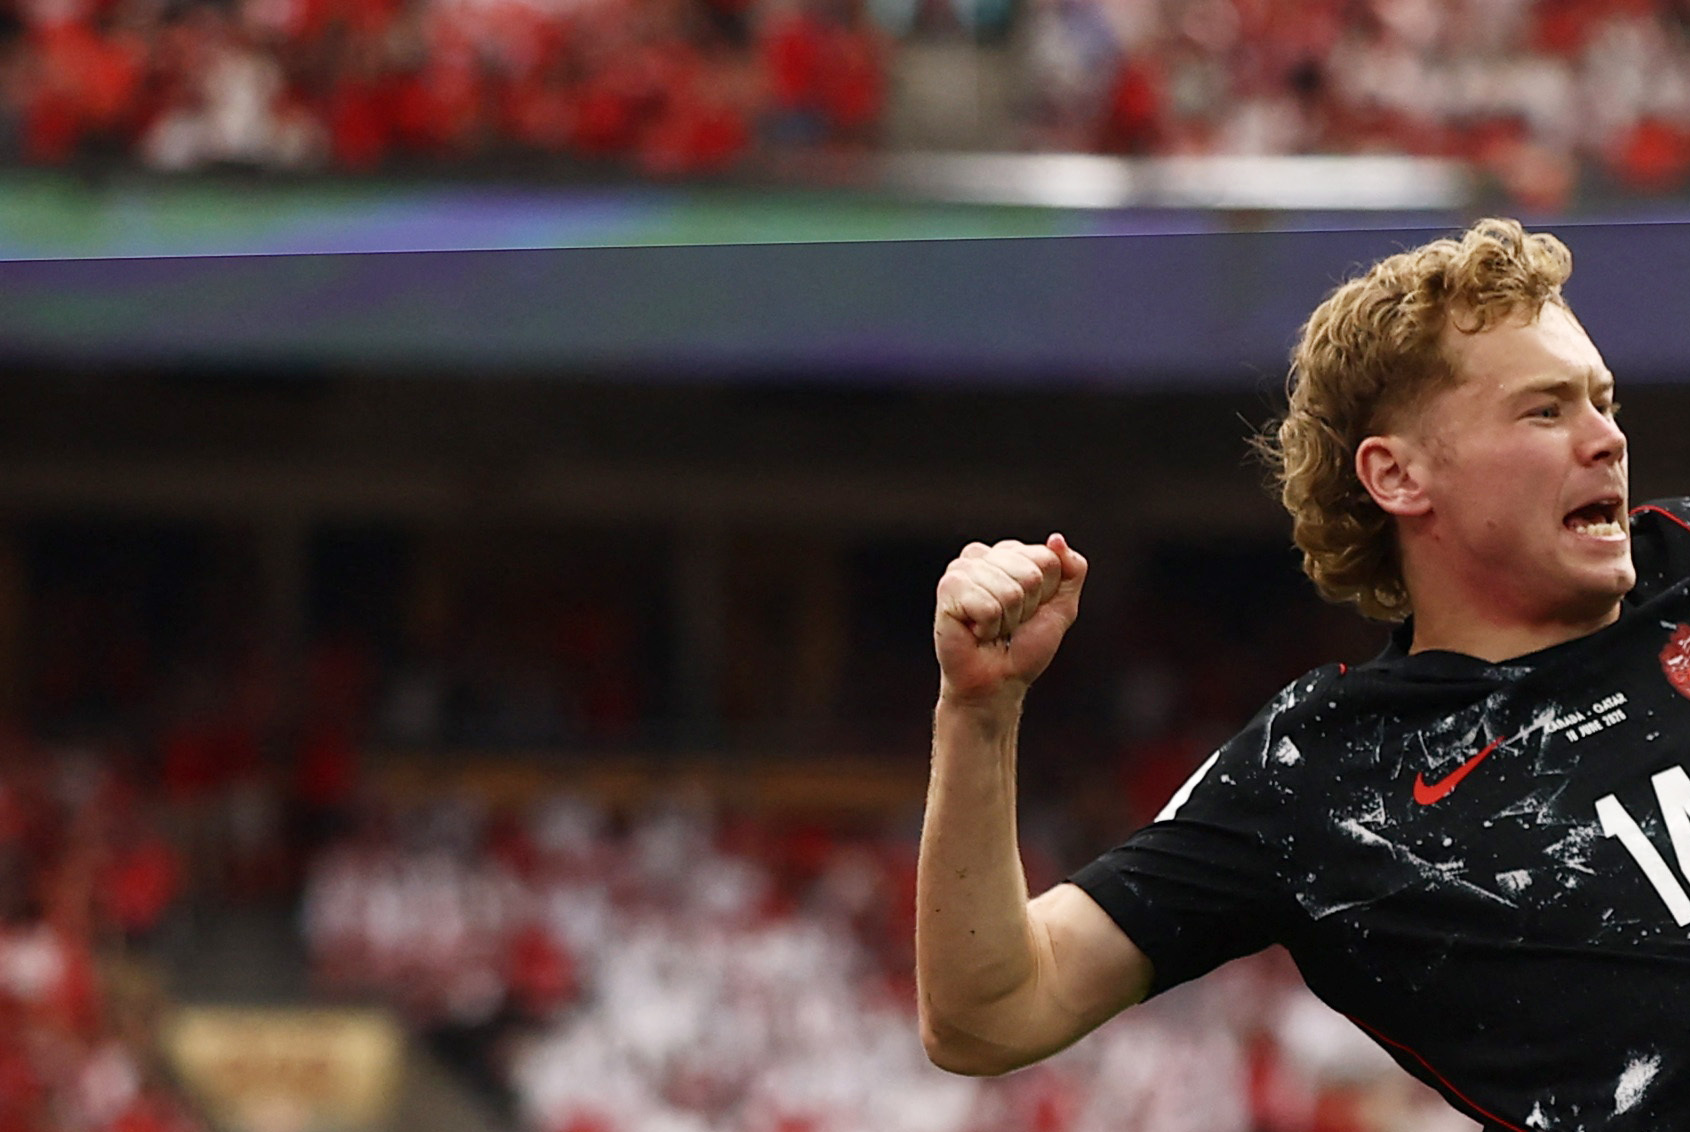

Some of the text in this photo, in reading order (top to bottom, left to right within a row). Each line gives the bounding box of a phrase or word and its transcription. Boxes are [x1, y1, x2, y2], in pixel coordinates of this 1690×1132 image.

[1544, 711, 1587, 733] CANADA
[1592, 692, 1628, 714] QATAR
[1578, 719, 1604, 738] JUNE
